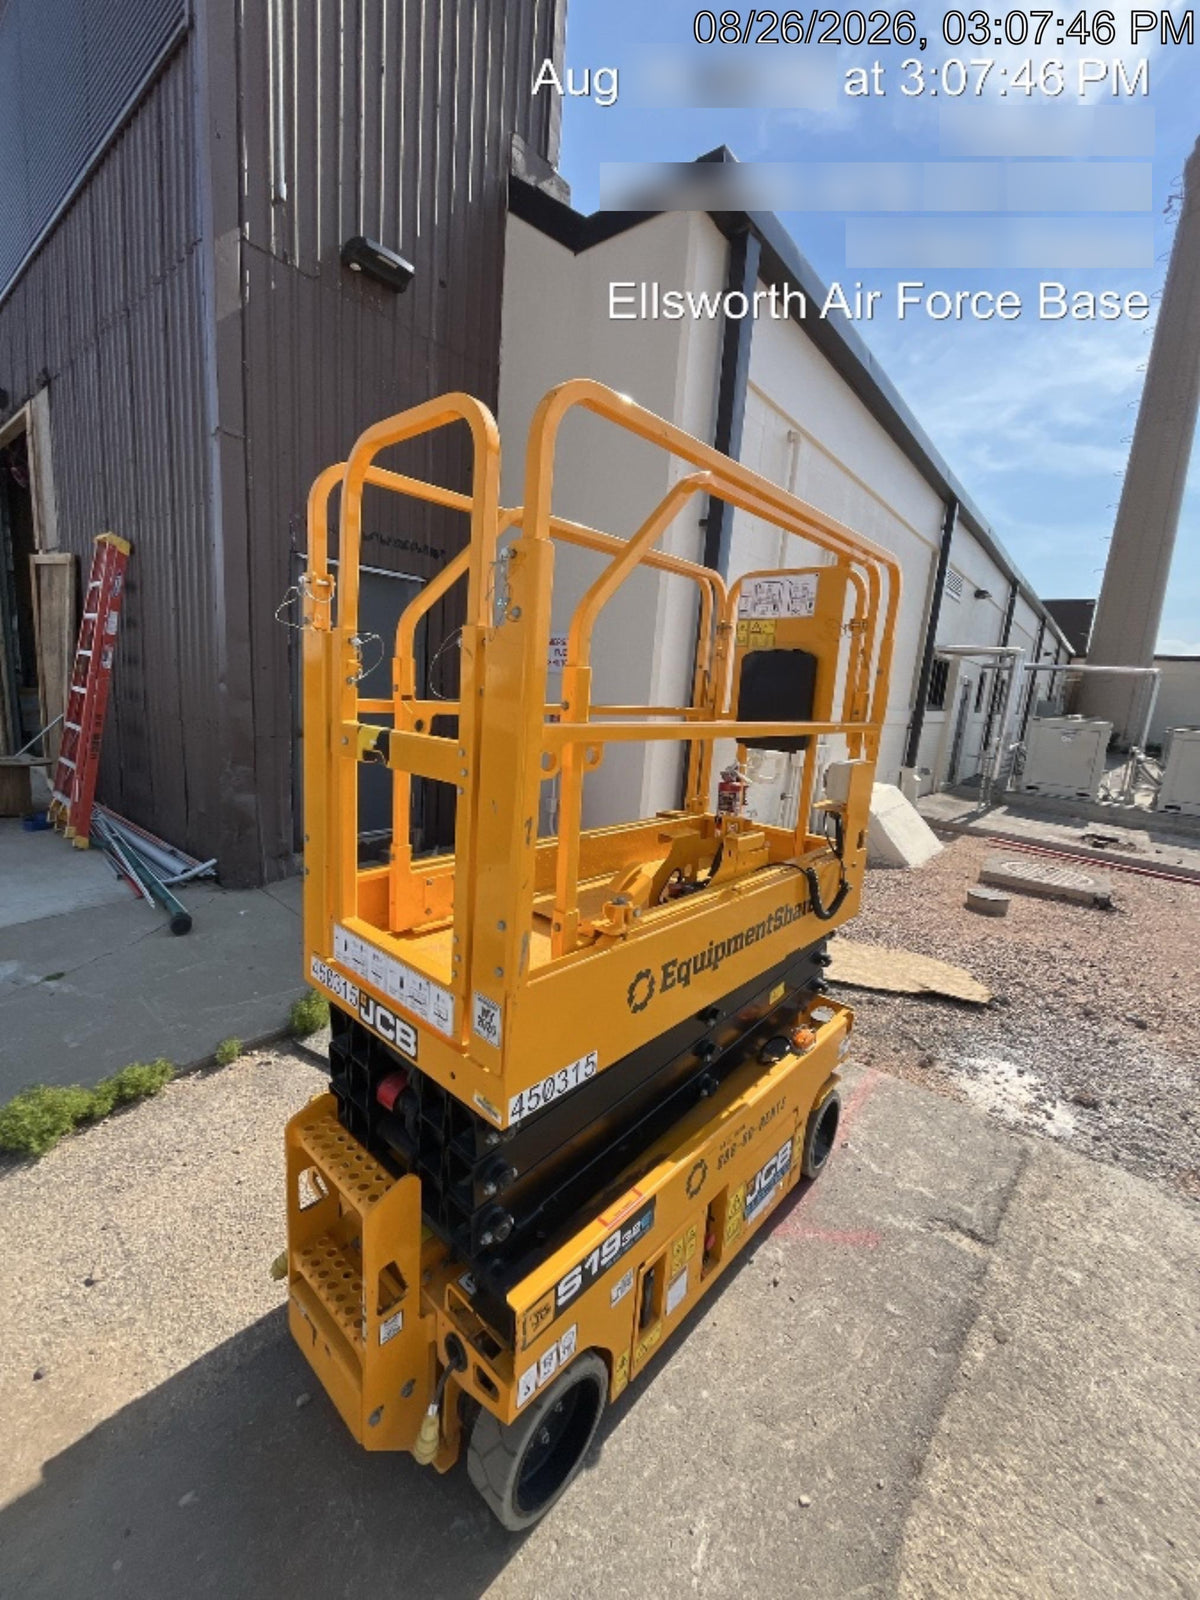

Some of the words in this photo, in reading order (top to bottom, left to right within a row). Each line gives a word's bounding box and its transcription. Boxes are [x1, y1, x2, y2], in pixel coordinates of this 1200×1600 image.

[360, 999, 417, 1057] JCB
[511, 1051, 597, 1118] 450315
[746, 1139, 792, 1206] JCB
